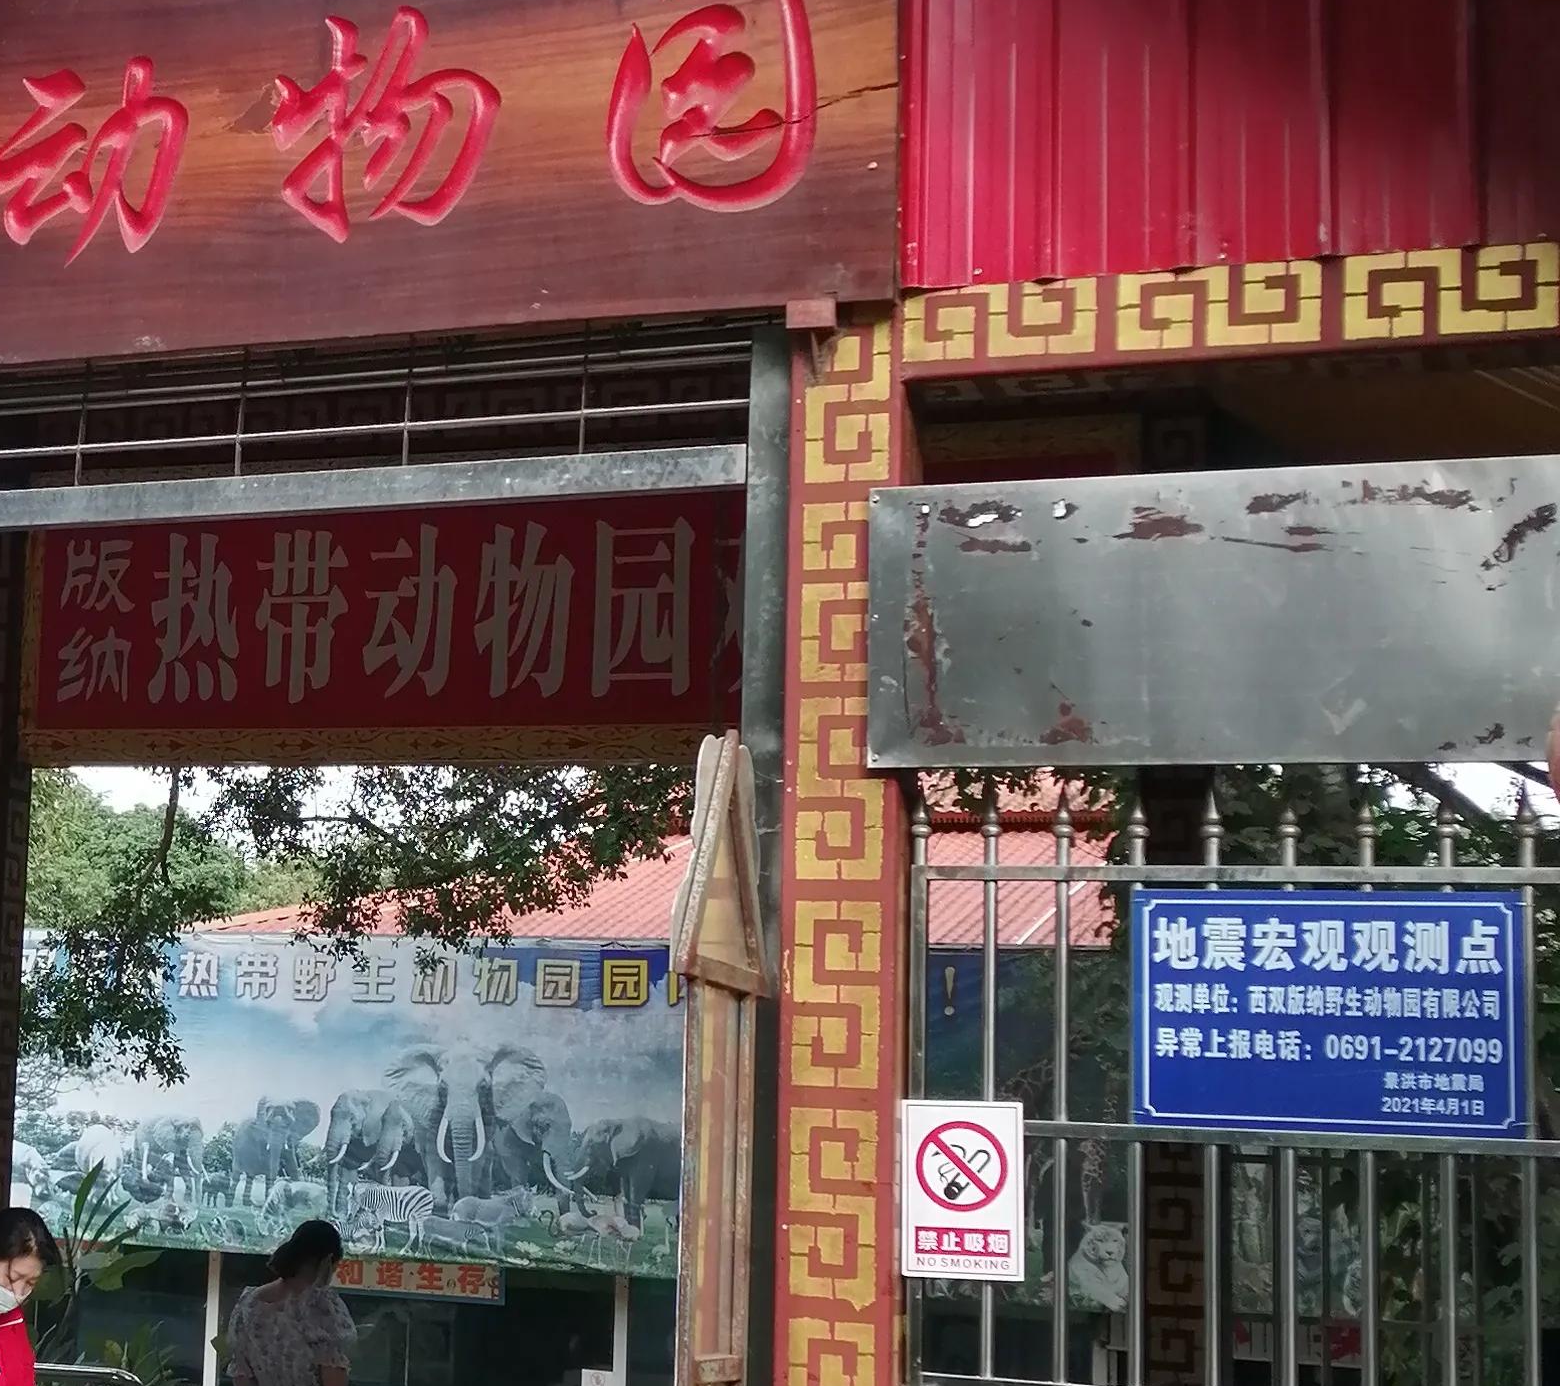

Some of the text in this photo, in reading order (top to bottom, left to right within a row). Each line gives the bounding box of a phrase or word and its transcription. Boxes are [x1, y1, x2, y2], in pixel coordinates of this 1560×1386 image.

[1152, 916, 1505, 975] 地震宏观观测点
[1383, 1072, 1485, 1093] 景洪市地震局
[1381, 1096, 1485, 1116] 2021年4月1日
[917, 1230, 1008, 1254] 禁止吸烟
[916, 1256, 1010, 1270] NO SMOKING
